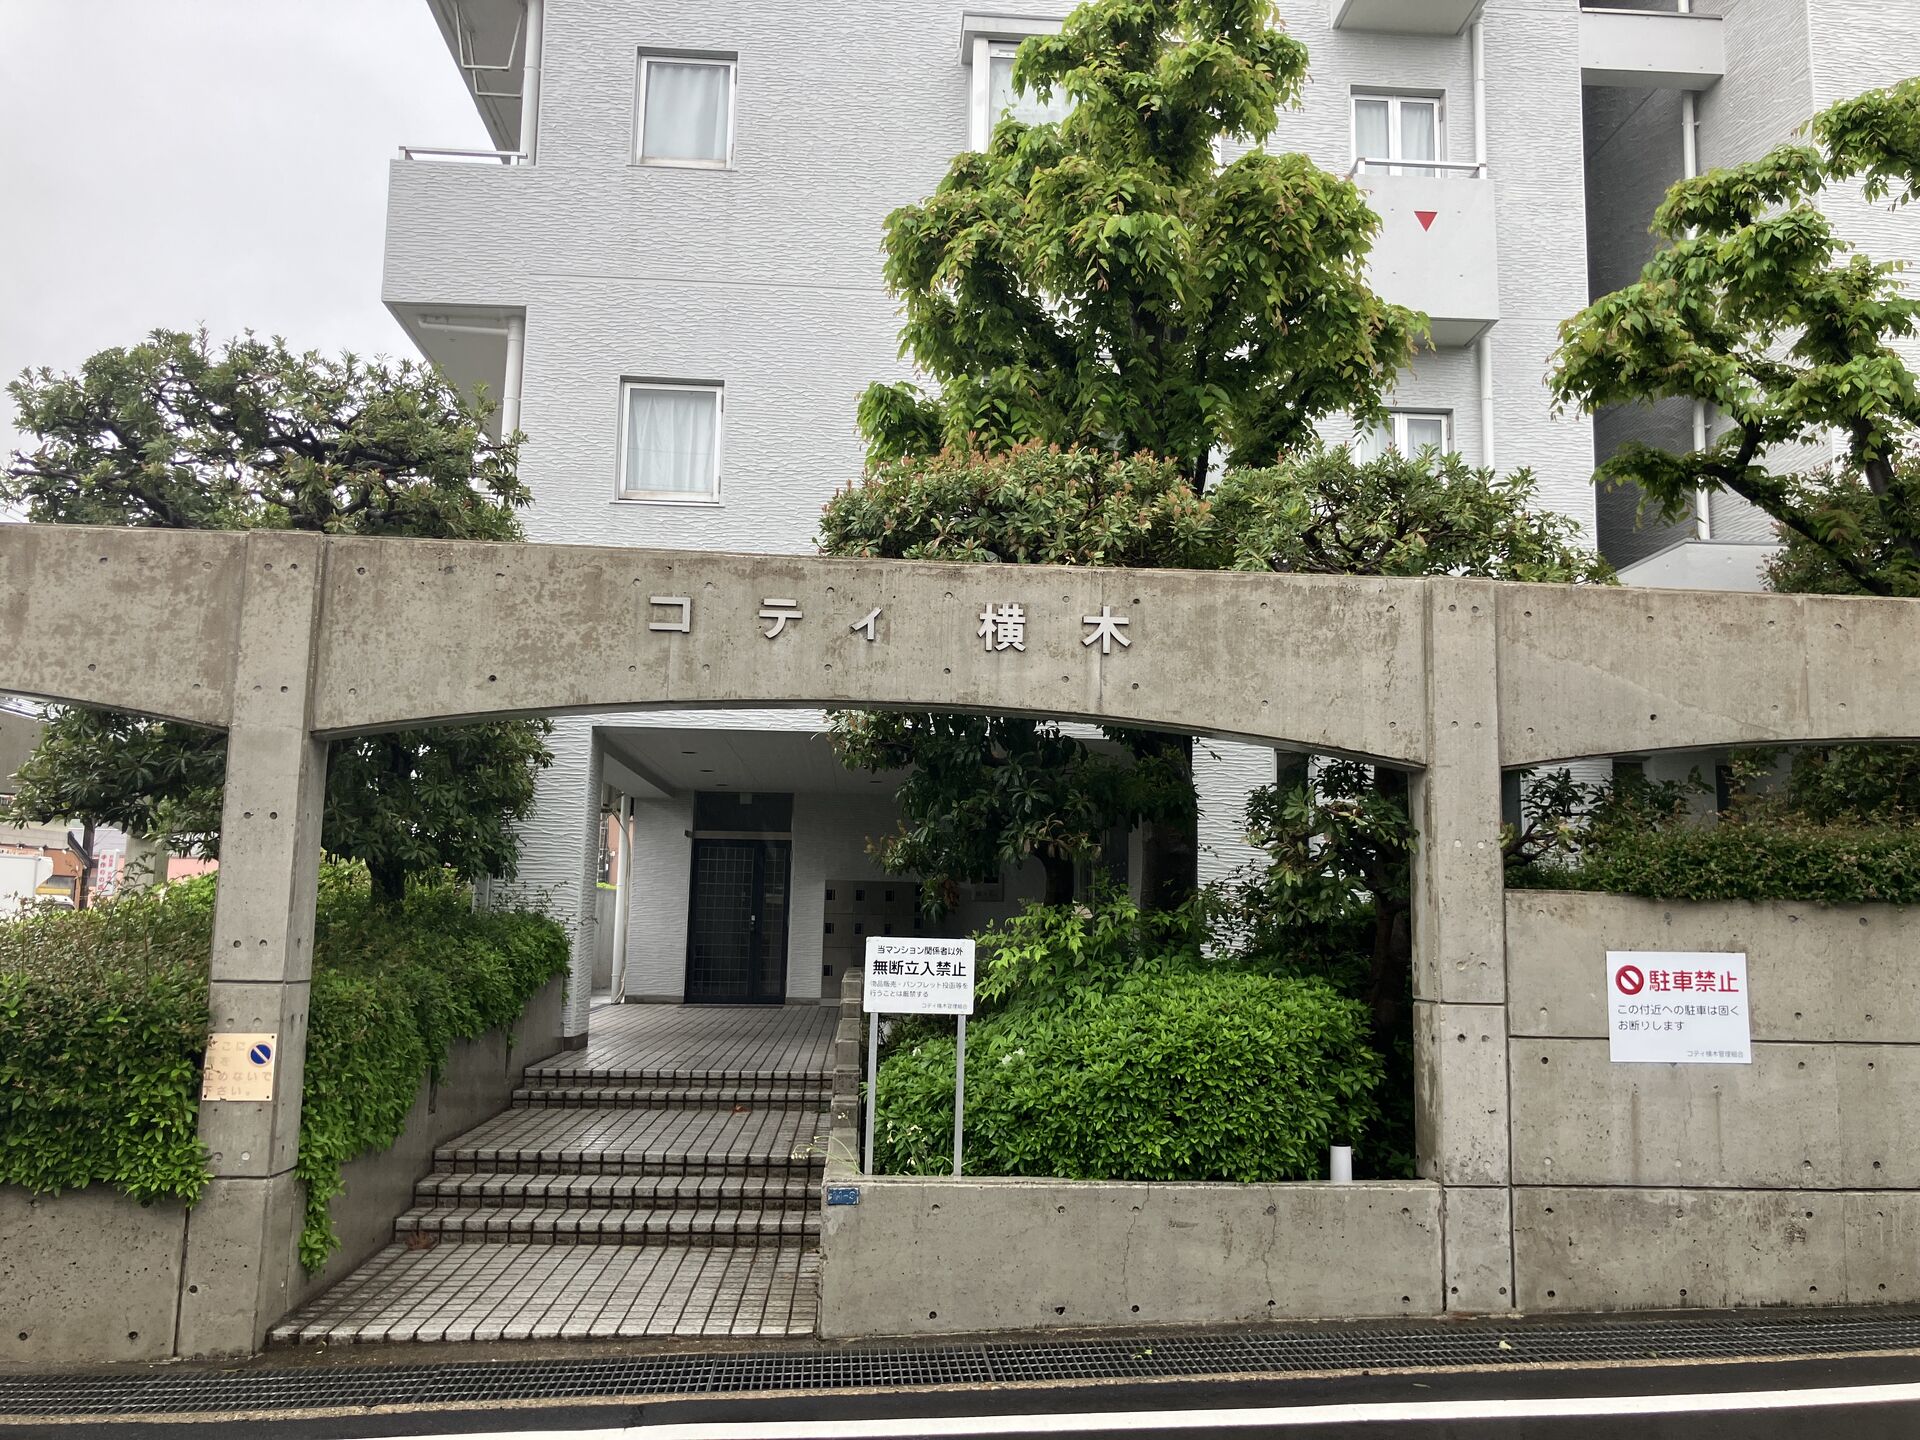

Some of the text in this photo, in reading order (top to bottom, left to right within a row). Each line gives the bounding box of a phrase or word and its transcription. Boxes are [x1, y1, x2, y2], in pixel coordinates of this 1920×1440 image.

[648, 596, 1132, 653] コティ横木
[877, 945, 963, 956] 当マンション関係者以外
[872, 960, 967, 977] 無断立入禁止
[1649, 970, 1739, 992] 駐車禁止
[1617, 1004, 1739, 1016] この付近への駐車は固く
[1618, 1020, 1684, 1031] お断りします
